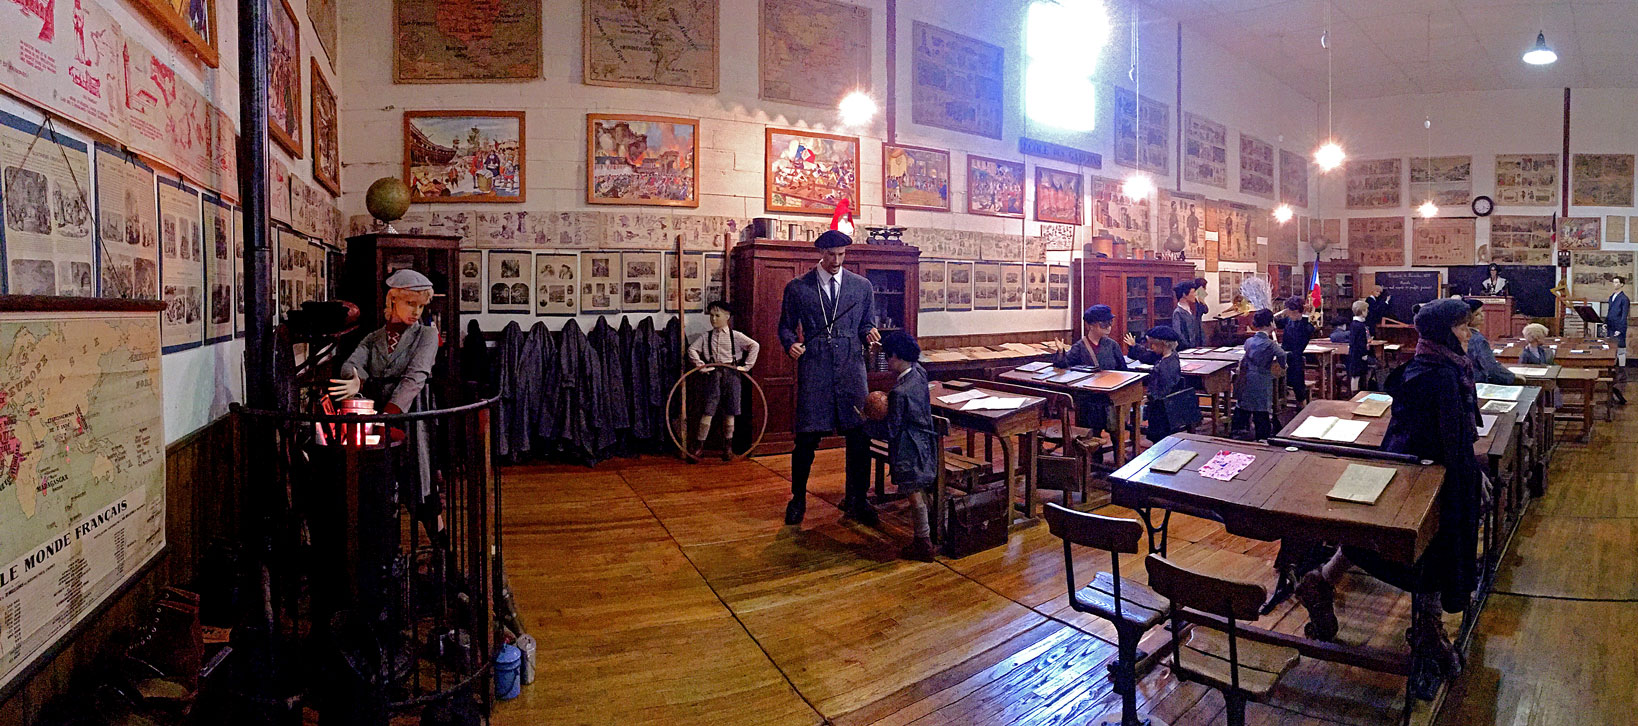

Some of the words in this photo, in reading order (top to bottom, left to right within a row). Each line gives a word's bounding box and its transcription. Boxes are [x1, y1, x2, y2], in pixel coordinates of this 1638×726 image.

[8, 354, 48, 398] EUROPE
[0, 564, 19, 588] LE
[23, 532, 72, 573] MONDE
[75, 499, 128, 540] FRANÇAIS
